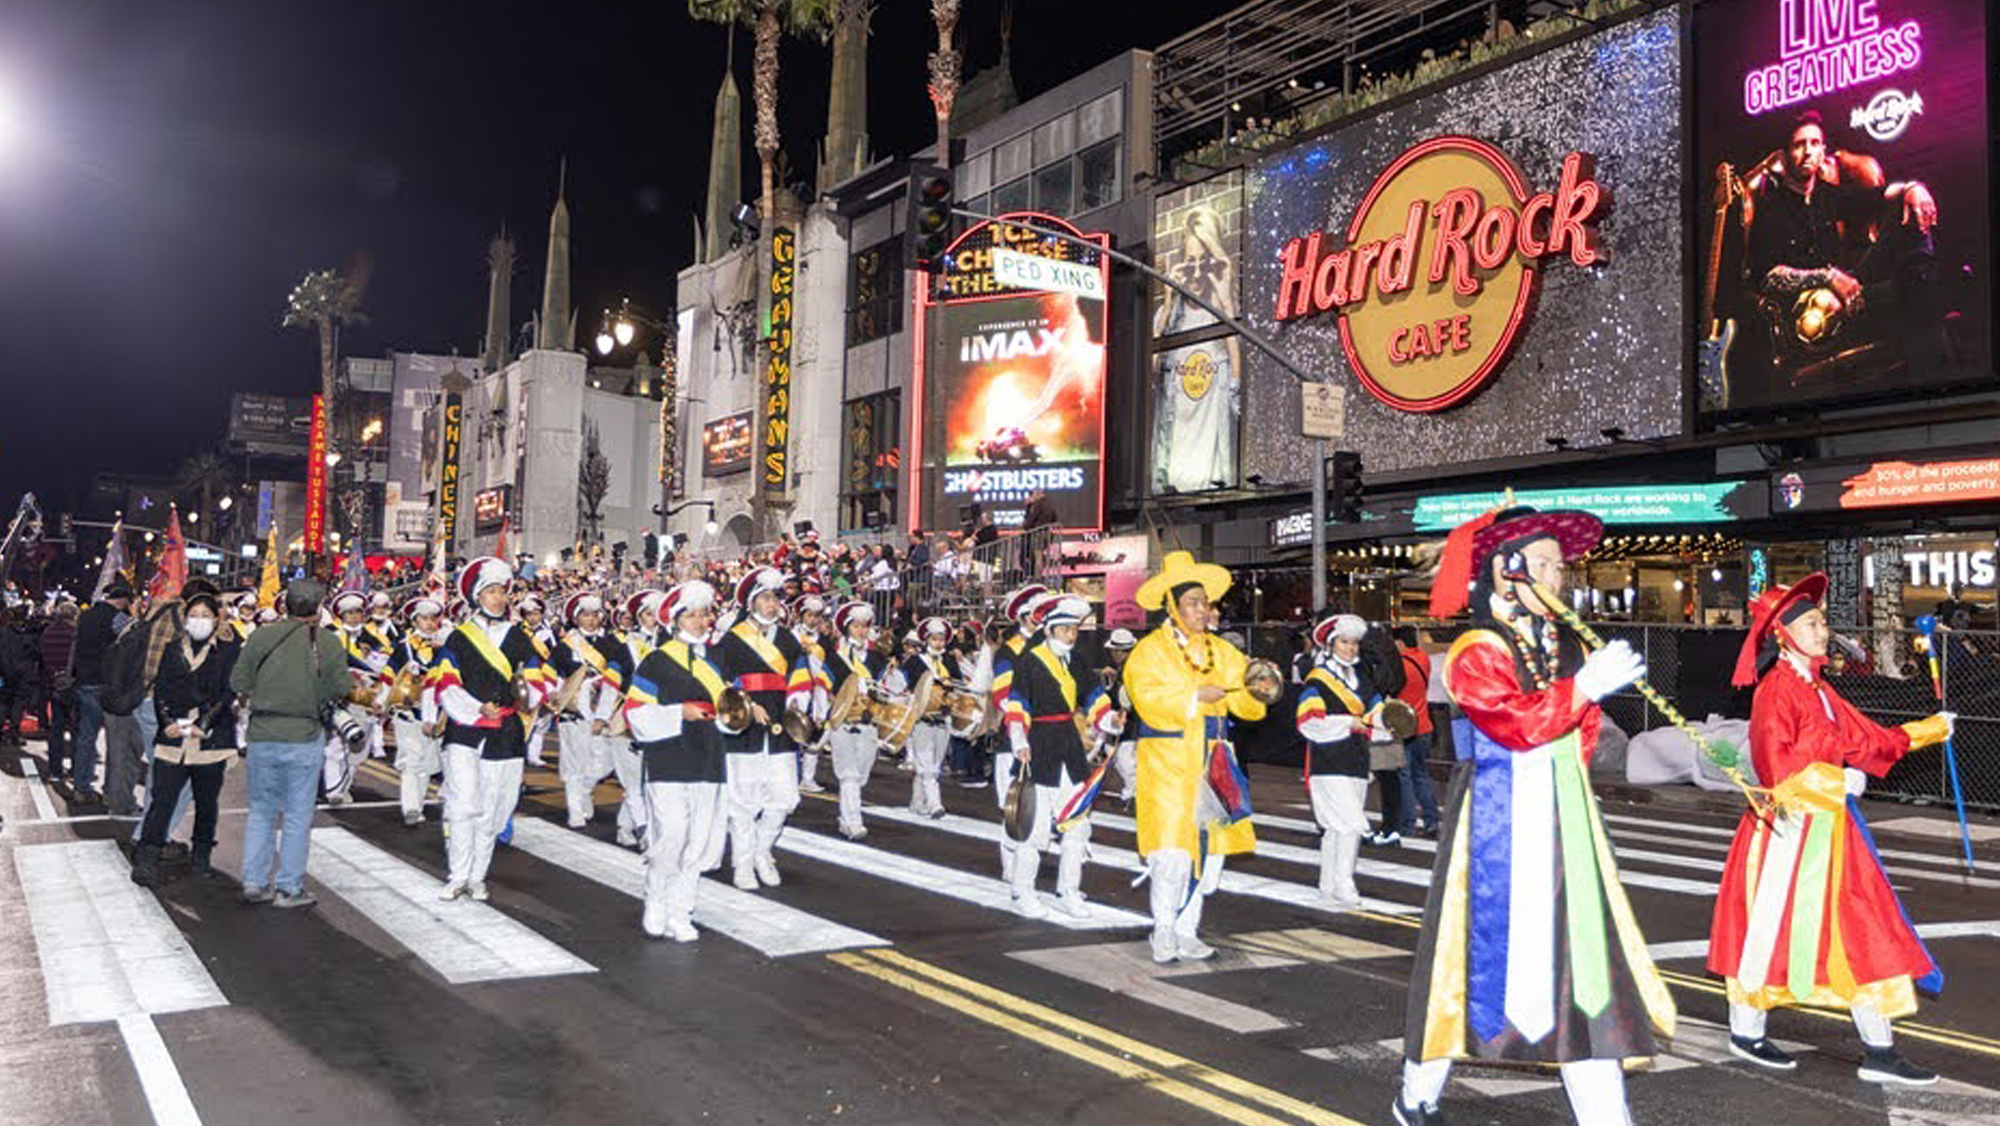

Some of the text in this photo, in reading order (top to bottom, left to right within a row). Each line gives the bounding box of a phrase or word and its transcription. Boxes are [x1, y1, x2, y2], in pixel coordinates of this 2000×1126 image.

[1744, 22, 1922, 115] GREATNESS
[1275, 151, 1603, 321] Hard Rock
[1002, 257, 1095, 291] PED XING
[960, 328, 1066, 362] IMAX
[1387, 314, 1472, 364] CAFE
[443, 406, 461, 540] CHINESE
[1942, 462, 1999, 479] proceeds
[1644, 492, 1690, 504] working
[1692, 491, 1706, 502] to
[1878, 485, 1919, 497] hunger
[1922, 482, 1946, 492] and
[1903, 551, 1995, 586] THIS
